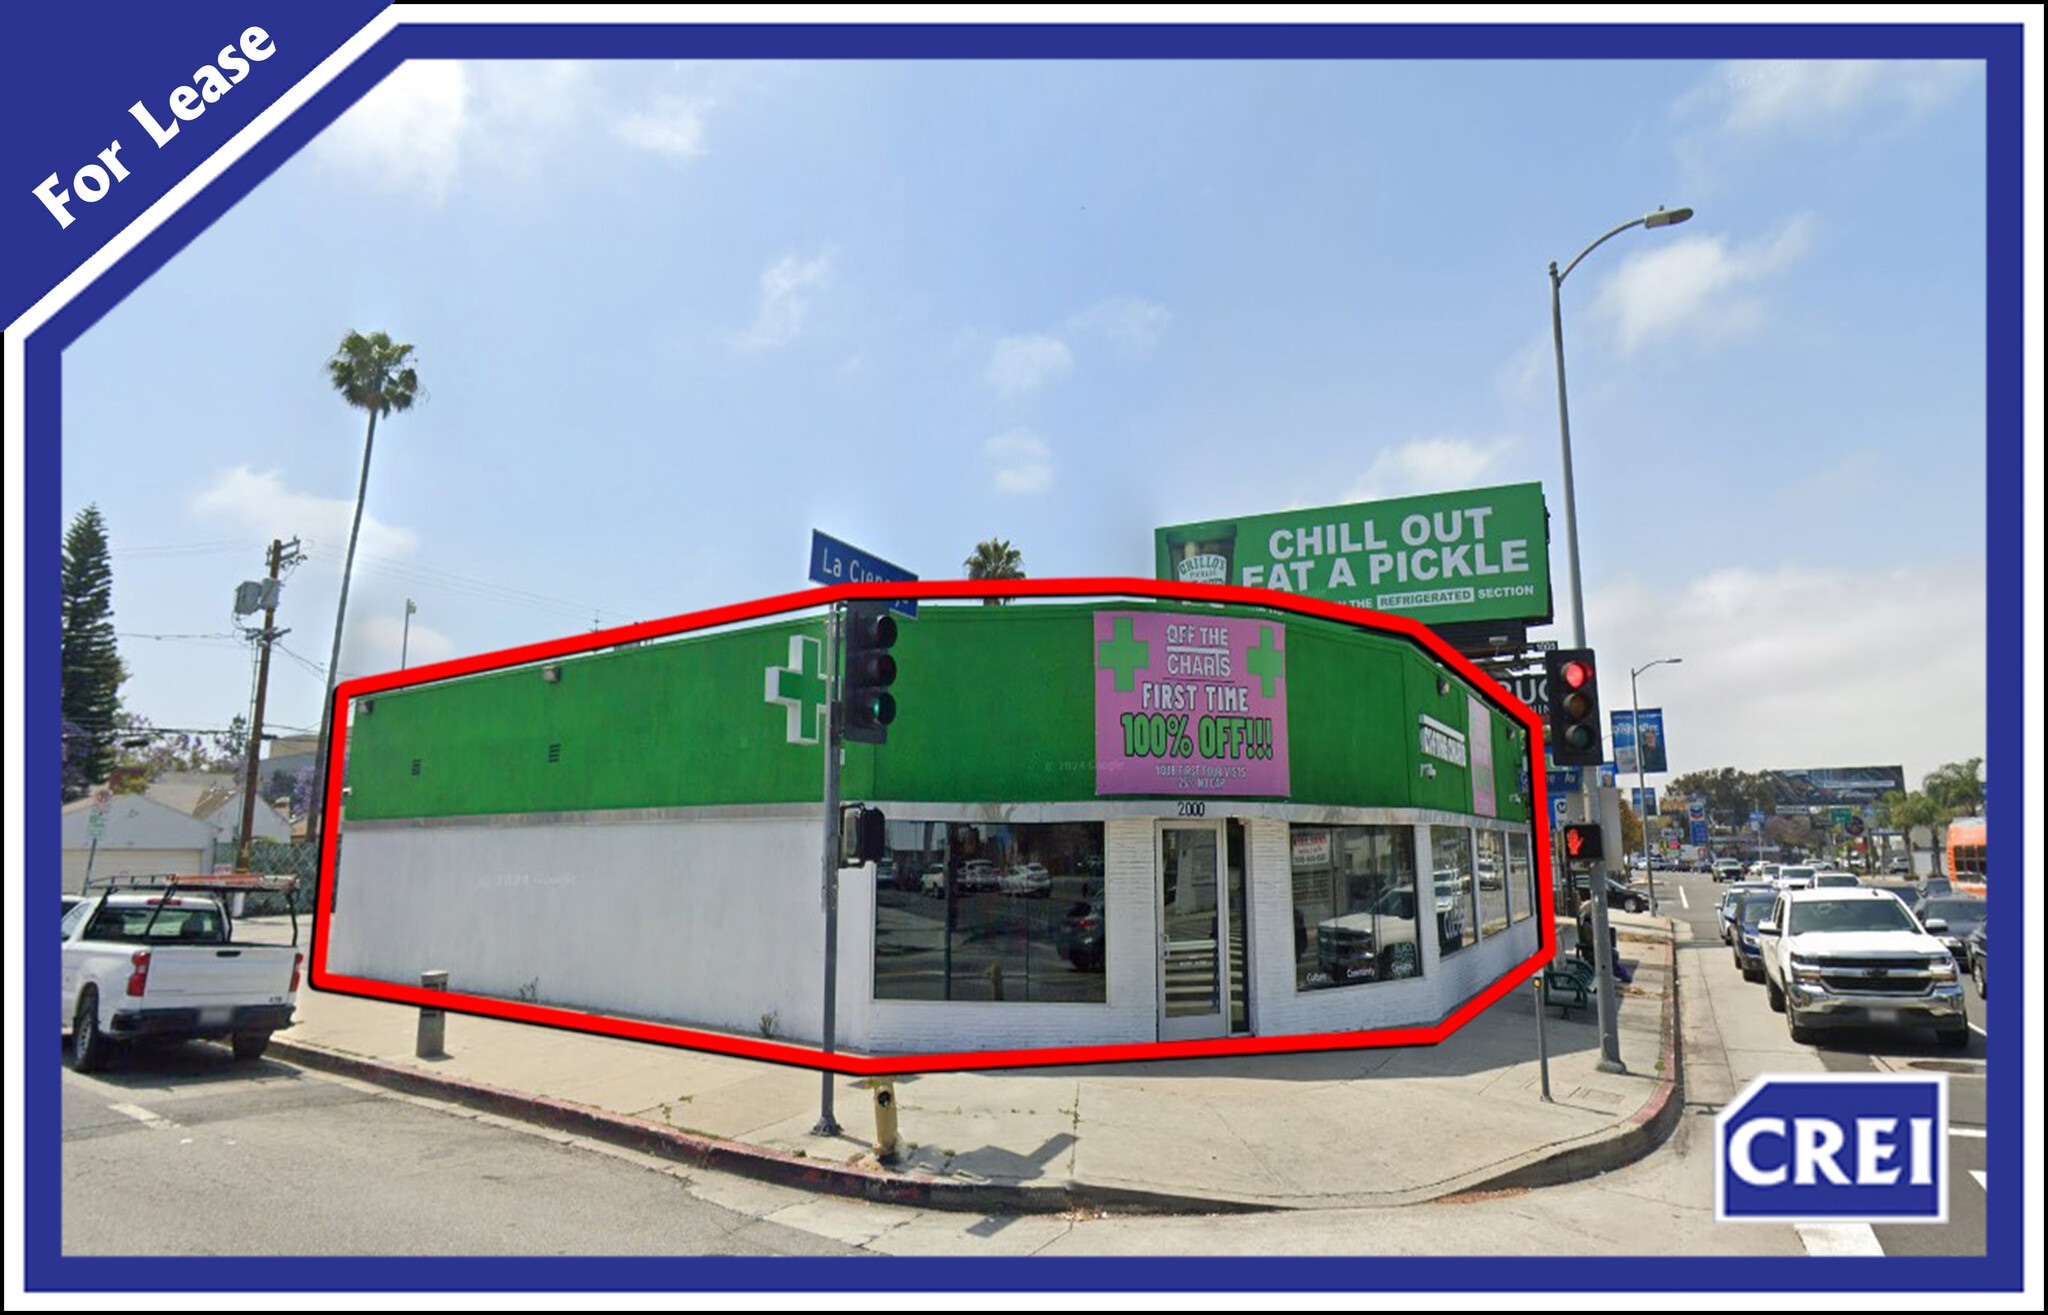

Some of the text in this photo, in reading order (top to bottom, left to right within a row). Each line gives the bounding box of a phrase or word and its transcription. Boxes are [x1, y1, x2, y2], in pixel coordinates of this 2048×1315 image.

[1269, 506, 1493, 560] CHILL OUT
[823, 547, 842, 578] La
[1242, 539, 1529, 591] EAT A PICKLE
[1379, 590, 1472, 609] REFRIGERATED
[1478, 585, 1534, 600] SECTION
[1166, 624, 1228, 646] OFF THE
[1166, 653, 1231, 677] CHARTS
[1142, 682, 1249, 712] FIRST TIME
[1121, 712, 1273, 760] 100% OFF!!!
[1178, 802, 1205, 817] 2000
